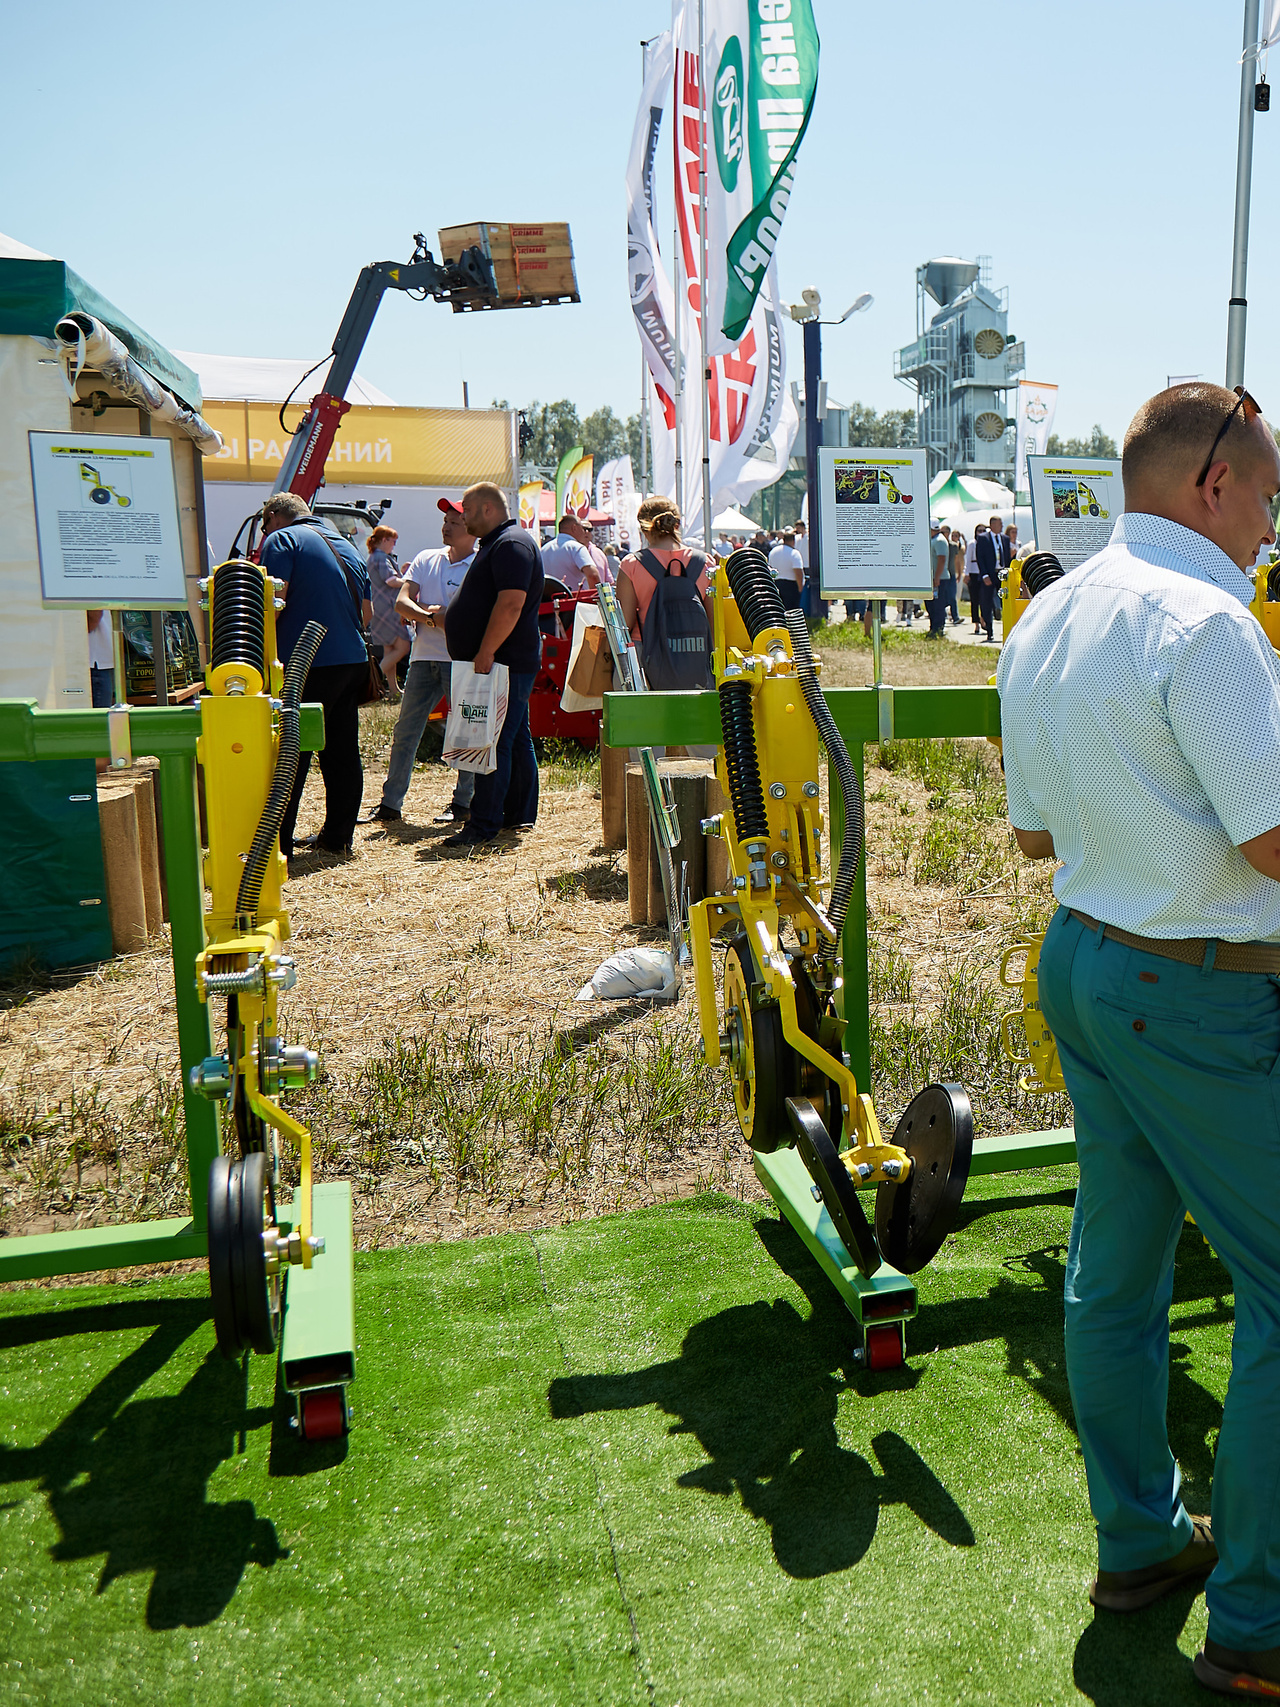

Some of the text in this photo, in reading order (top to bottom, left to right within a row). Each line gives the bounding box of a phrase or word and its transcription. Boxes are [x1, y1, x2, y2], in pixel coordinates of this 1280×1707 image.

[512, 228, 544, 236] GRIMME
[249, 438, 392, 463] РАНИЙ
[298, 421, 324, 475] WEIDEMANN
